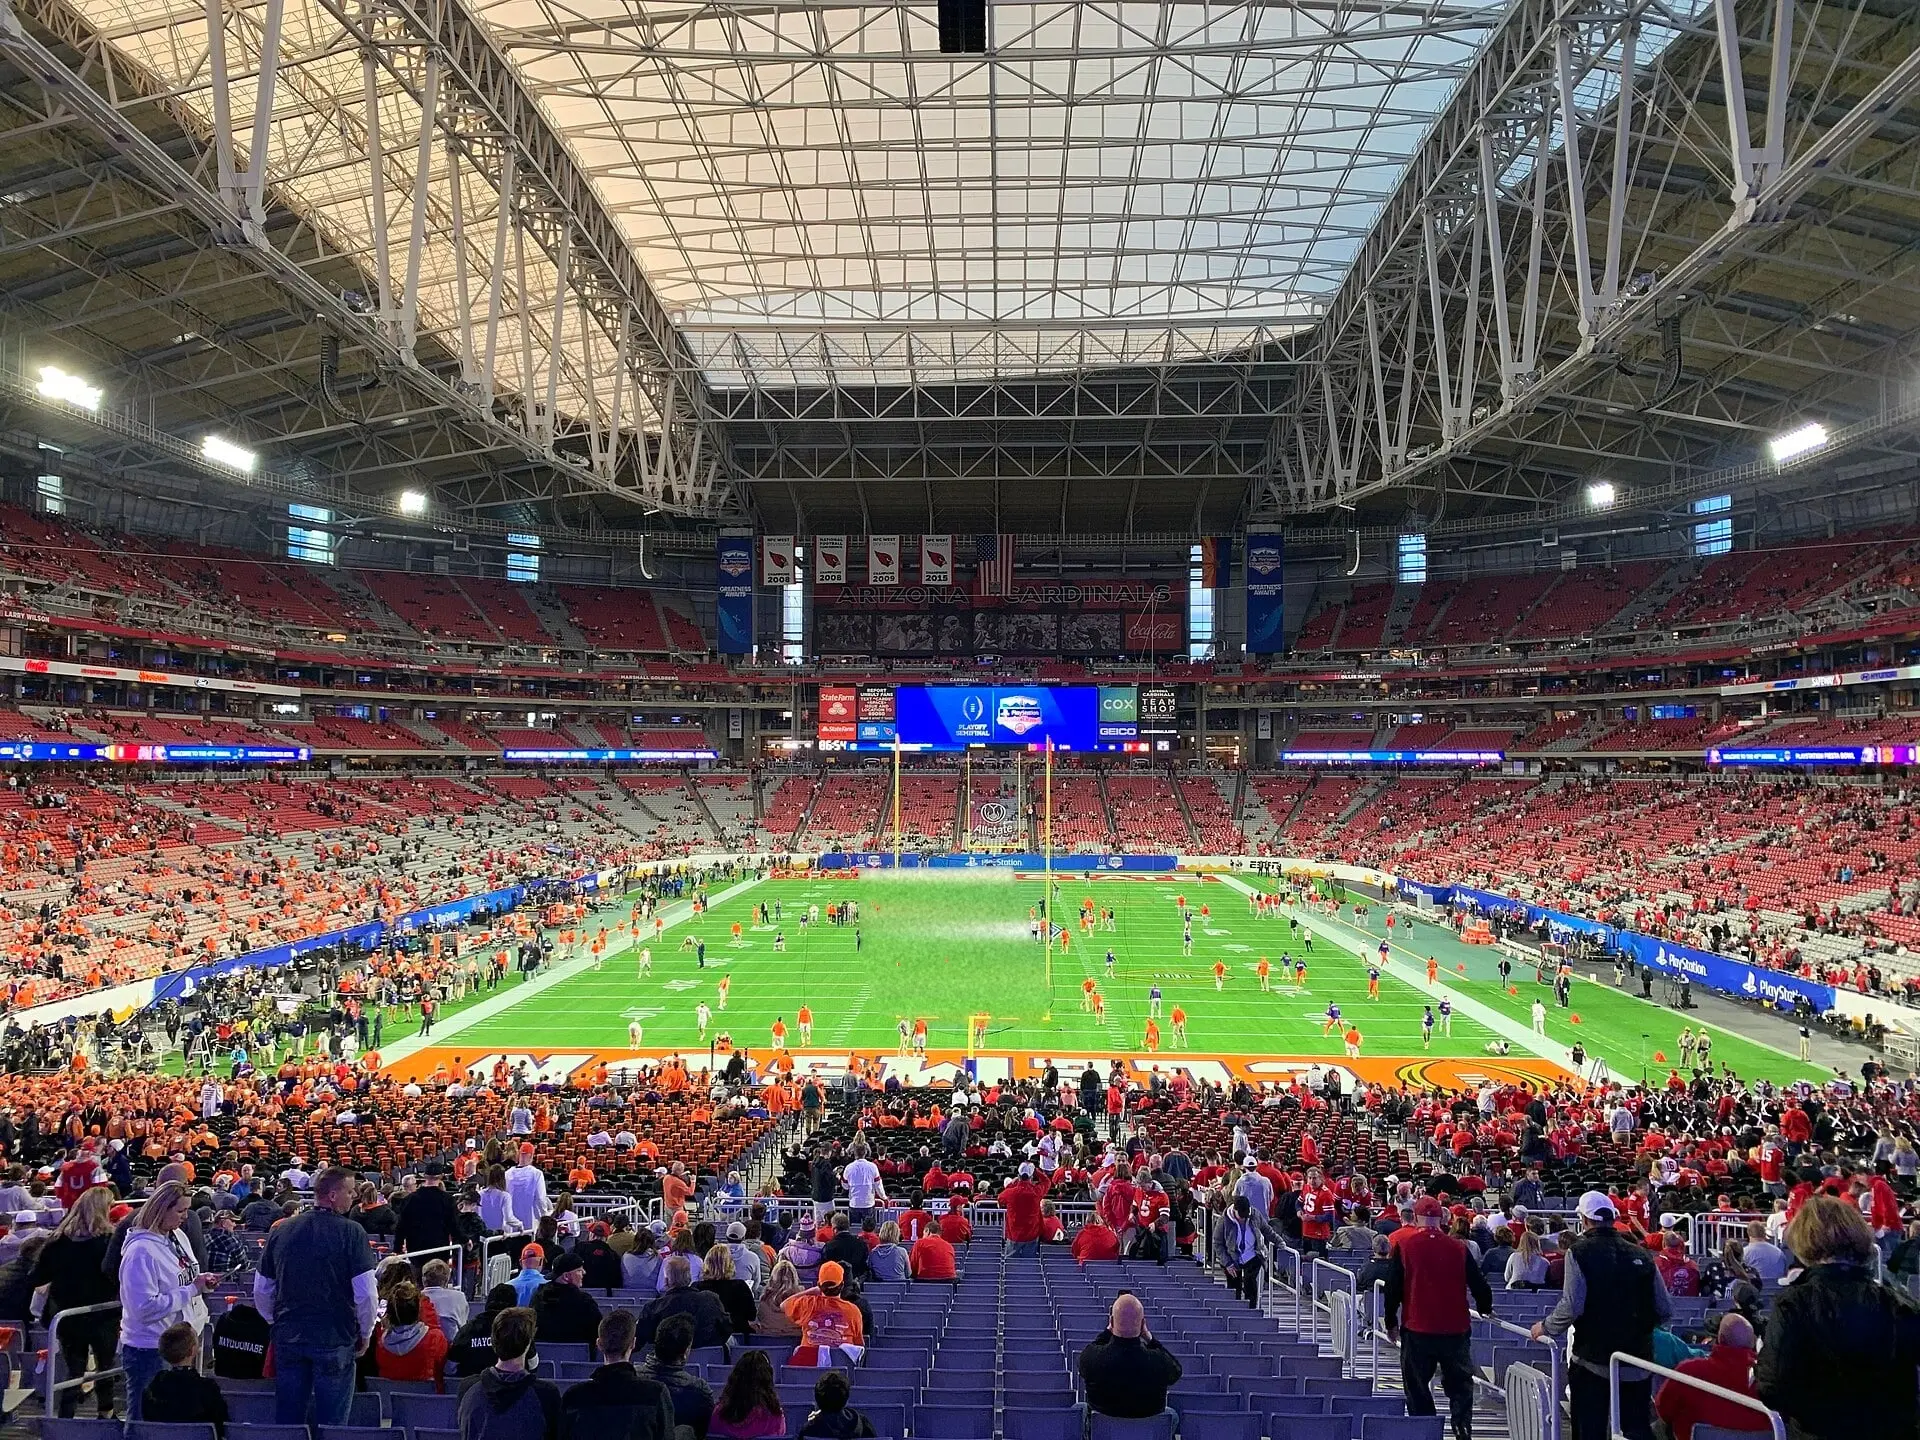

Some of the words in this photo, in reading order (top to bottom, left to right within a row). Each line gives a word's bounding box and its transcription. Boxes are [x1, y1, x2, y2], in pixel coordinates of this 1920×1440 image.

[925, 574, 948, 582] 2015
[836, 586, 970, 604] ARIZONA
[1003, 585, 1172, 604] CARDINALS
[4, 610, 26, 619] LARRY
[26, 613, 50, 623] WILSON
[1103, 699, 1134, 710] COX
[1142, 698, 1176, 706] TEAM
[1142, 705, 1176, 713] SHOP
[1099, 727, 1137, 736] GEICO
[973, 824, 1013, 835] Allstate
[1668, 953, 1708, 977] PlayStation
[1759, 979, 1811, 1006] PlayStatn
[1761, 1149, 1774, 1162] 15
[1665, 1160, 1675, 1170] 16
[70, 1174, 85, 1190] U
[1064, 1170, 1073, 1183] 5
[910, 1217, 919, 1241] 1
